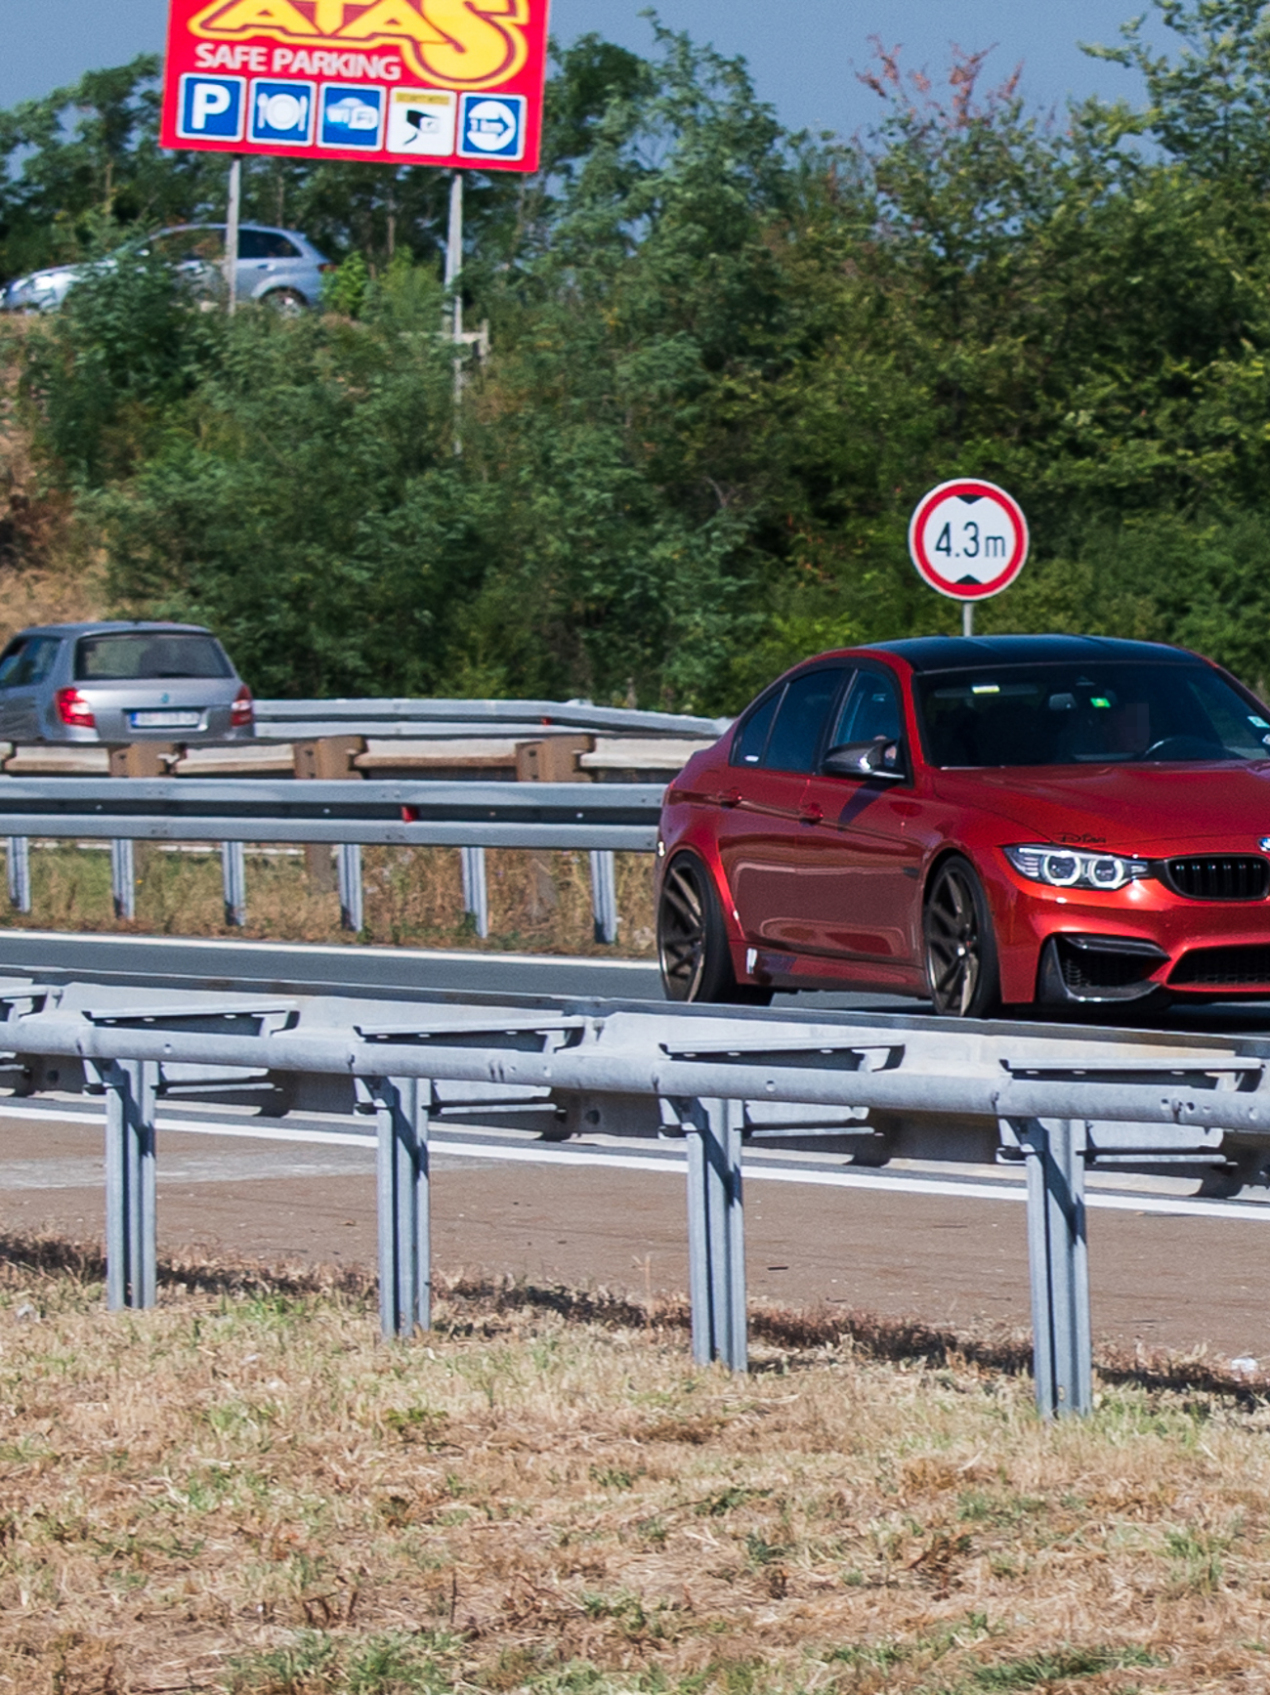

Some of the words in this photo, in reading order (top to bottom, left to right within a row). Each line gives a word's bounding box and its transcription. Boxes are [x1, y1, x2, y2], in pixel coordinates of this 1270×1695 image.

[194, 43, 268, 73] SAFE
[271, 47, 401, 81] PARKING
[191, 83, 232, 130] P
